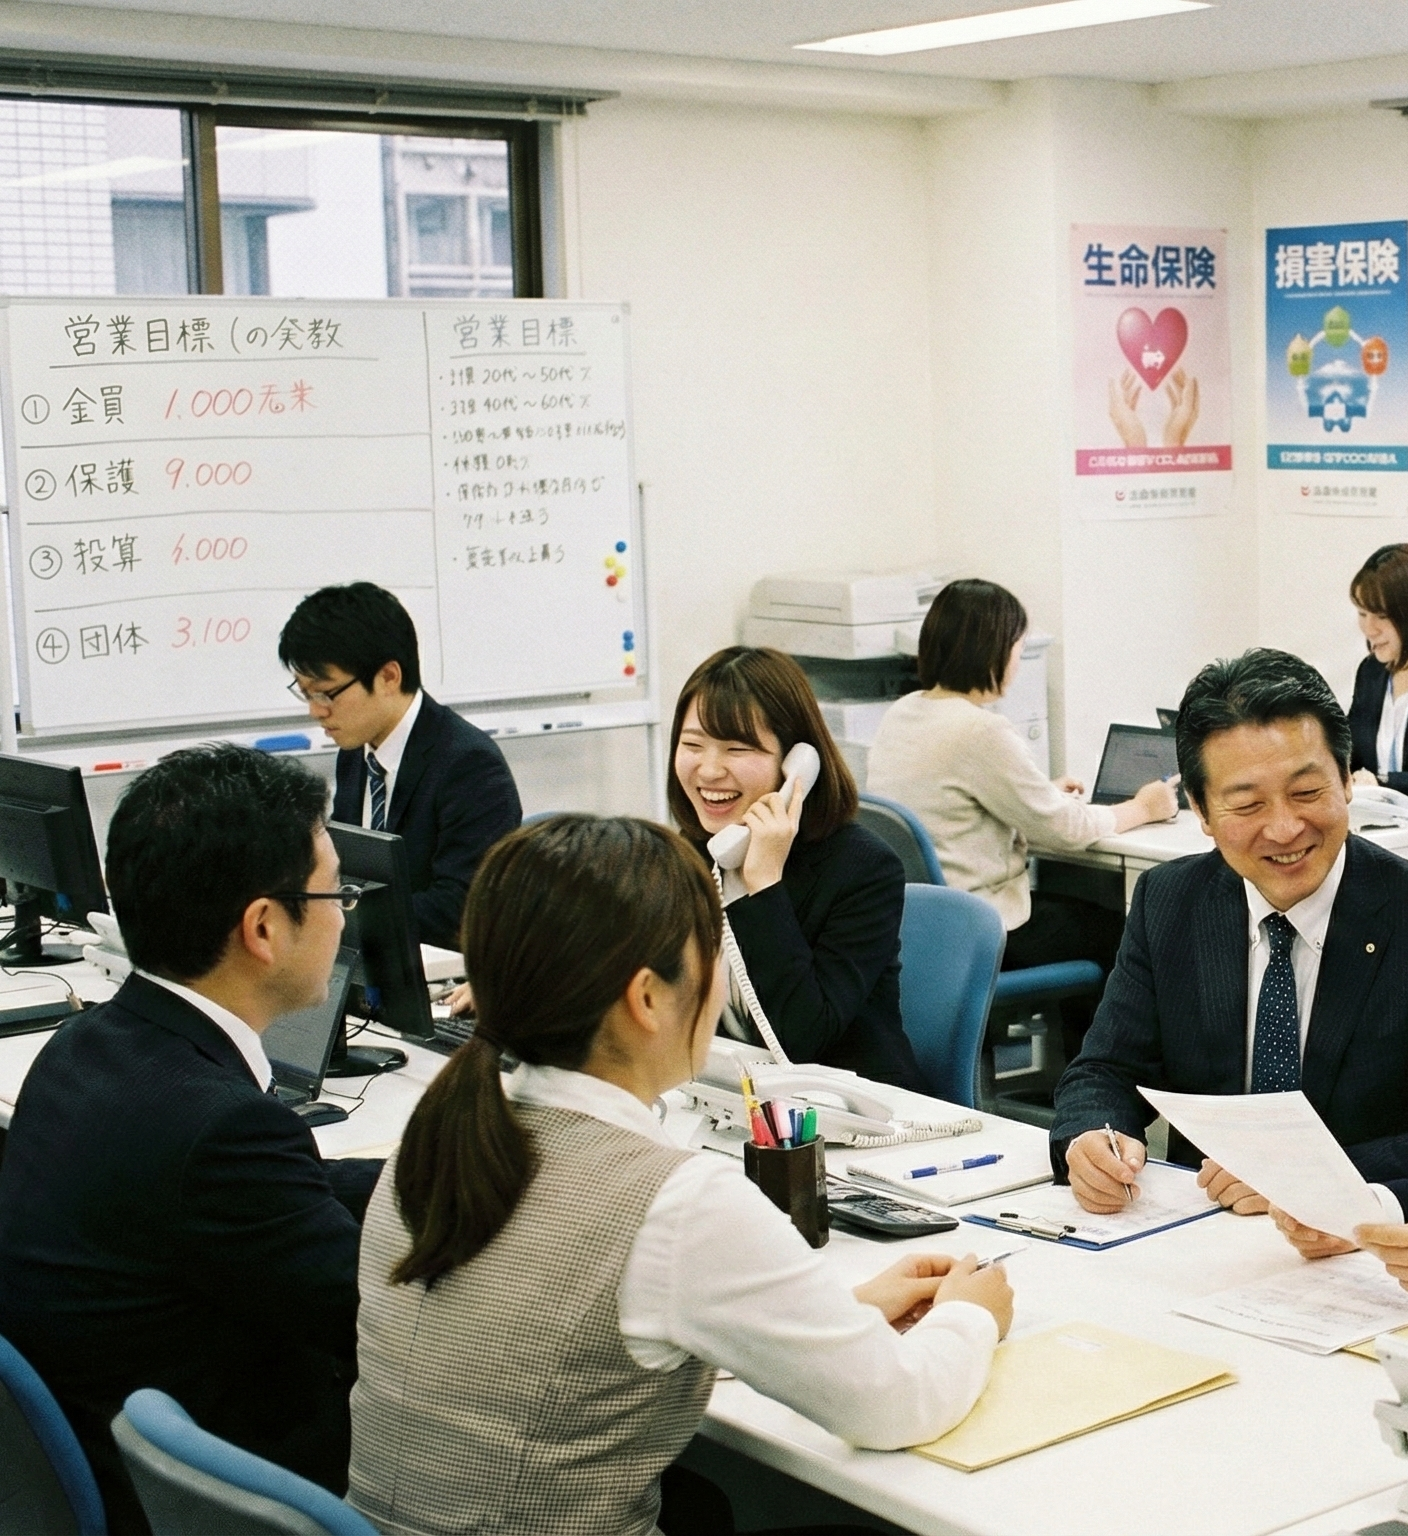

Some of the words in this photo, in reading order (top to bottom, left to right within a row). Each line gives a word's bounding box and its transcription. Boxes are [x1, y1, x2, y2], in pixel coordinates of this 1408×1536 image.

[1082, 242, 1217, 290] 生命保険
[1274, 237, 1400, 290] 損害保険
[453, 314, 578, 350] 営業目標
[65, 457, 139, 498] 保護
[80, 621, 149, 660] 団体
